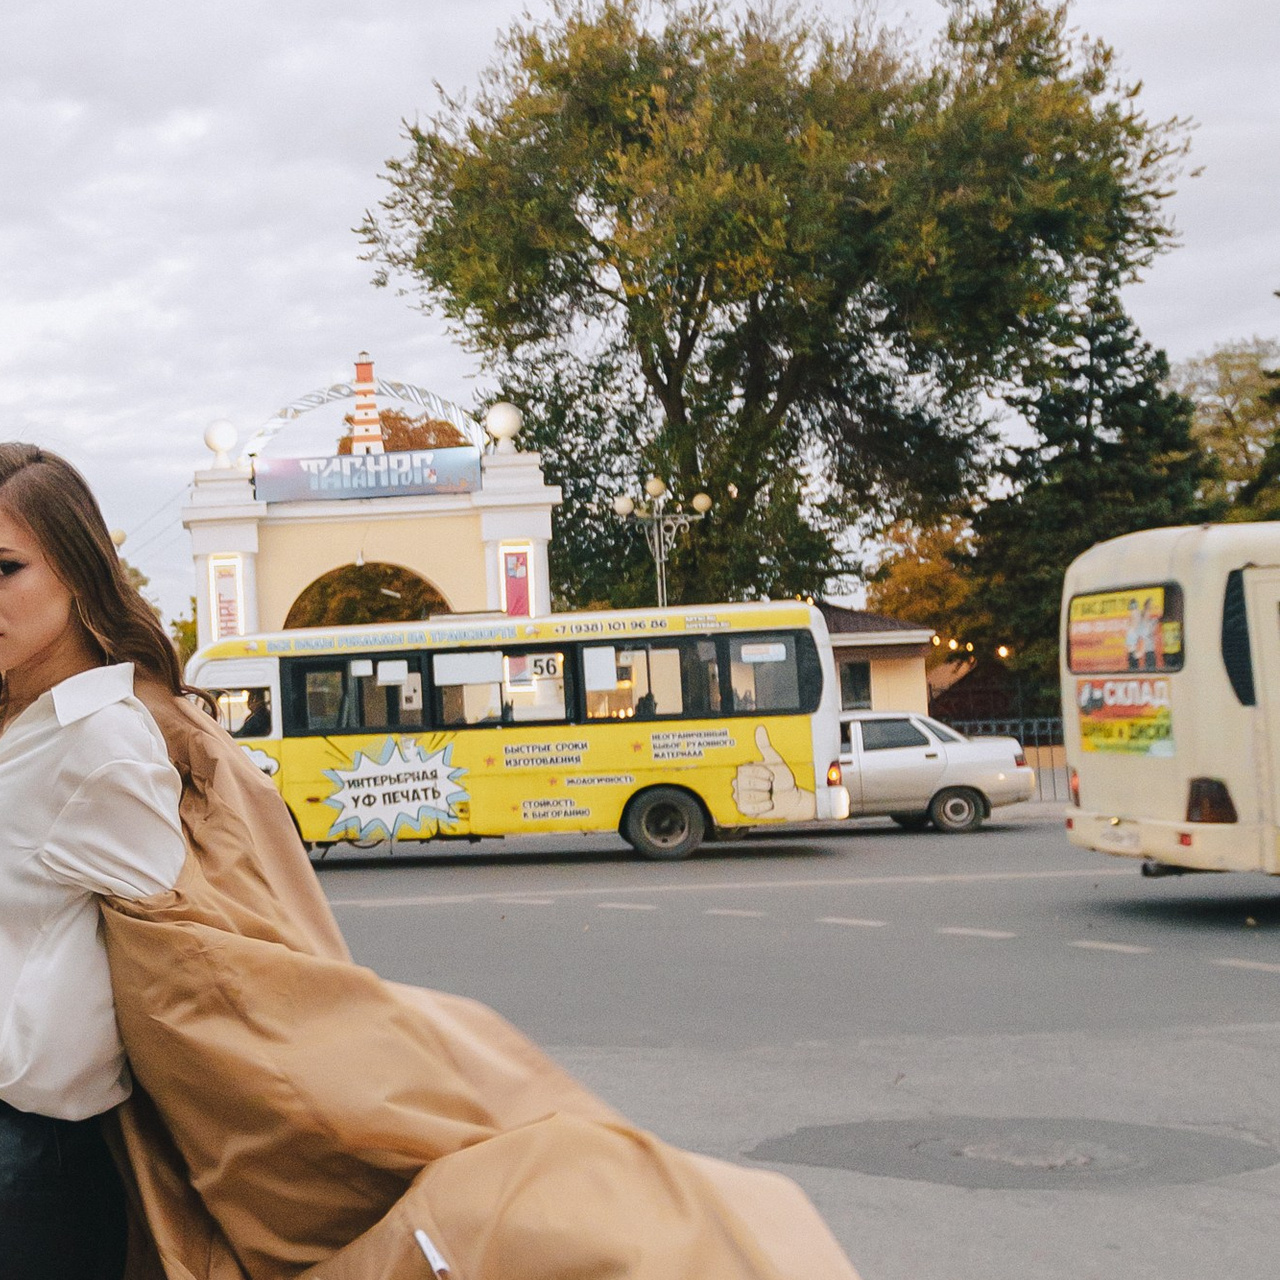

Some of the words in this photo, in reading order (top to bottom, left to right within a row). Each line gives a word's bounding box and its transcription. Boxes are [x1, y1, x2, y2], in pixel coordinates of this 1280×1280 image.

[533, 658, 557, 675] 56
[504, 743, 551, 755] БЫСТРЫЕ
[555, 742, 588, 752] СРОКИ
[505, 755, 581, 767] ИЗГОТОВЛЕНИЯ
[346, 769, 438, 789] ИНТЕРЬЕРНАЯ
[351, 794, 377, 809] УФ
[382, 787, 441, 805] ПЕЧАТЬ
[522, 799, 575, 808] СТОЙКОСТЬ
